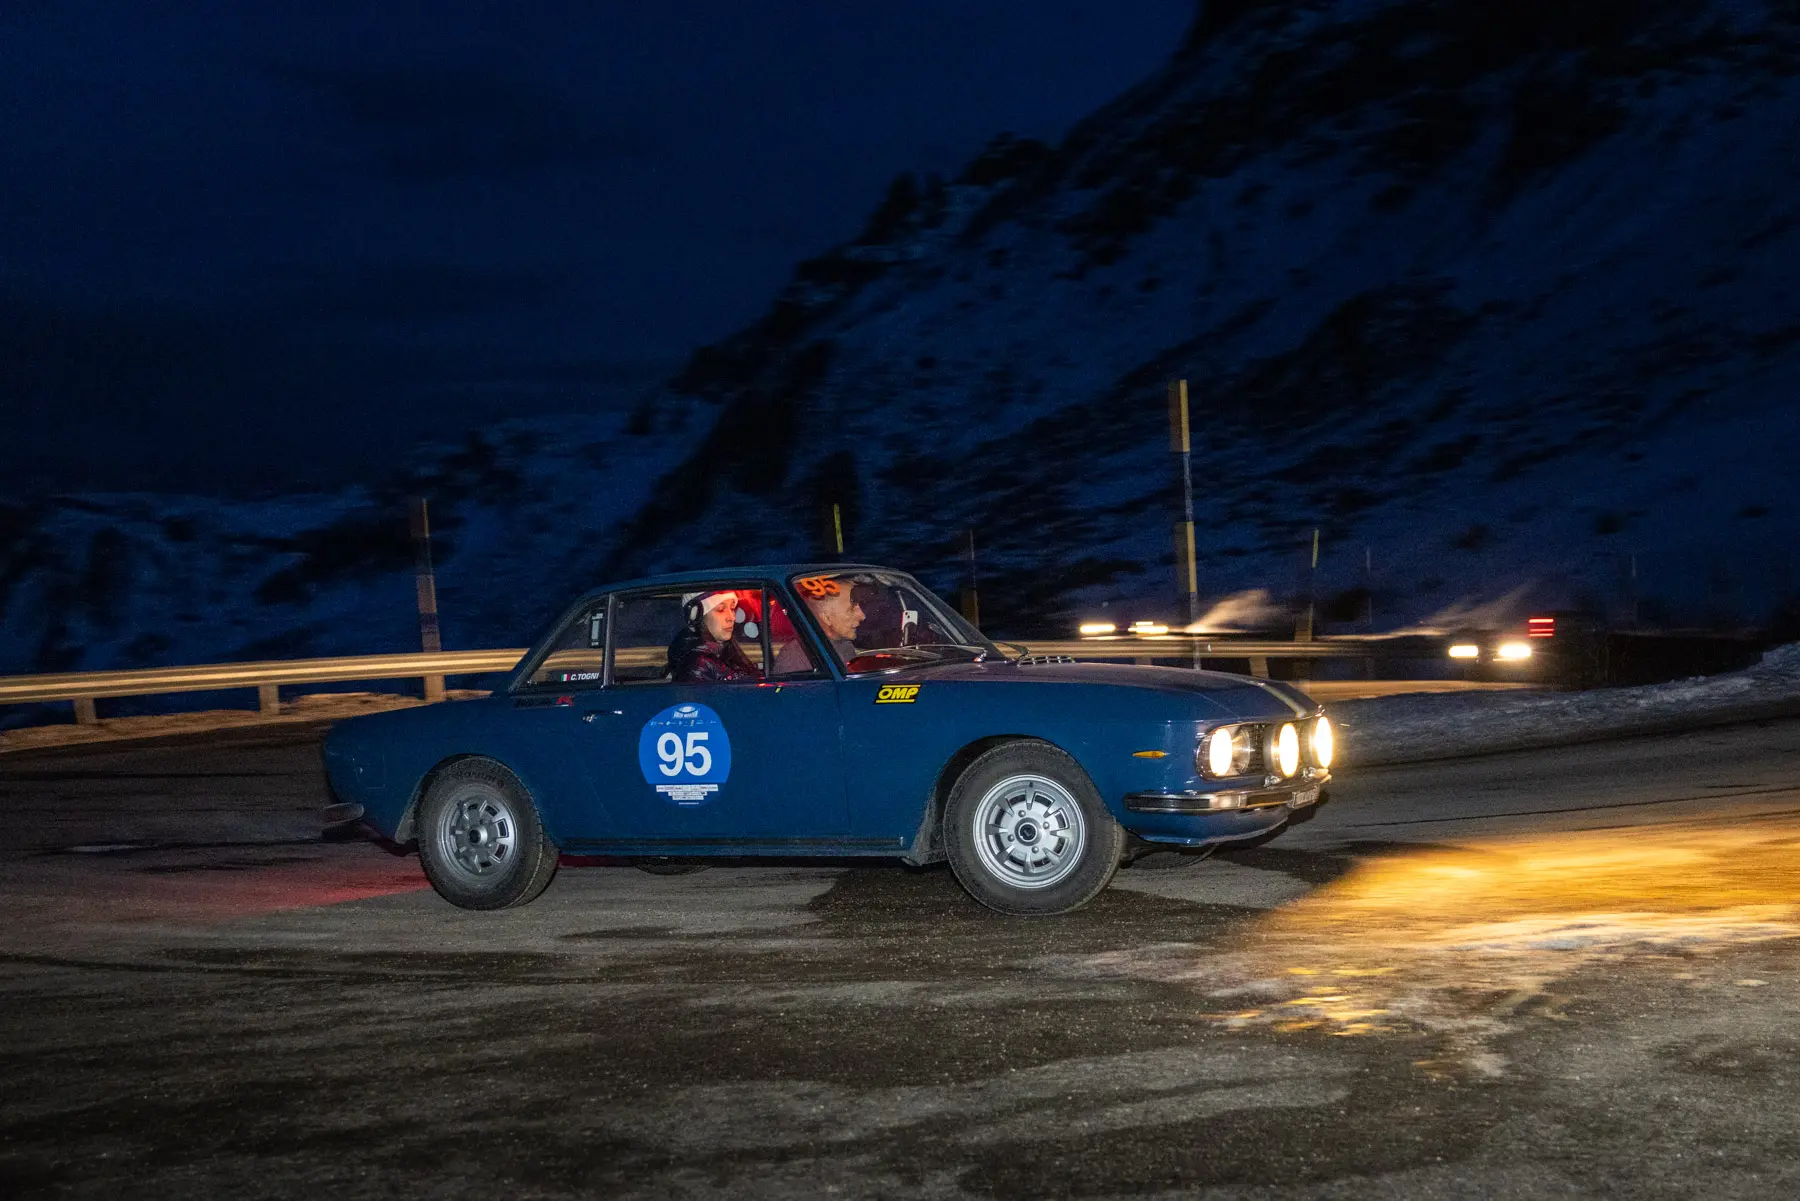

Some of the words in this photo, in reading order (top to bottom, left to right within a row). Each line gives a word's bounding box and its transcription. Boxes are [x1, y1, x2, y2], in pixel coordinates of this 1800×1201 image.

[801, 575, 840, 597] 95
[570, 673, 600, 681] C.TOGNI
[878, 687, 919, 700] OMP
[657, 732, 712, 777] 95
